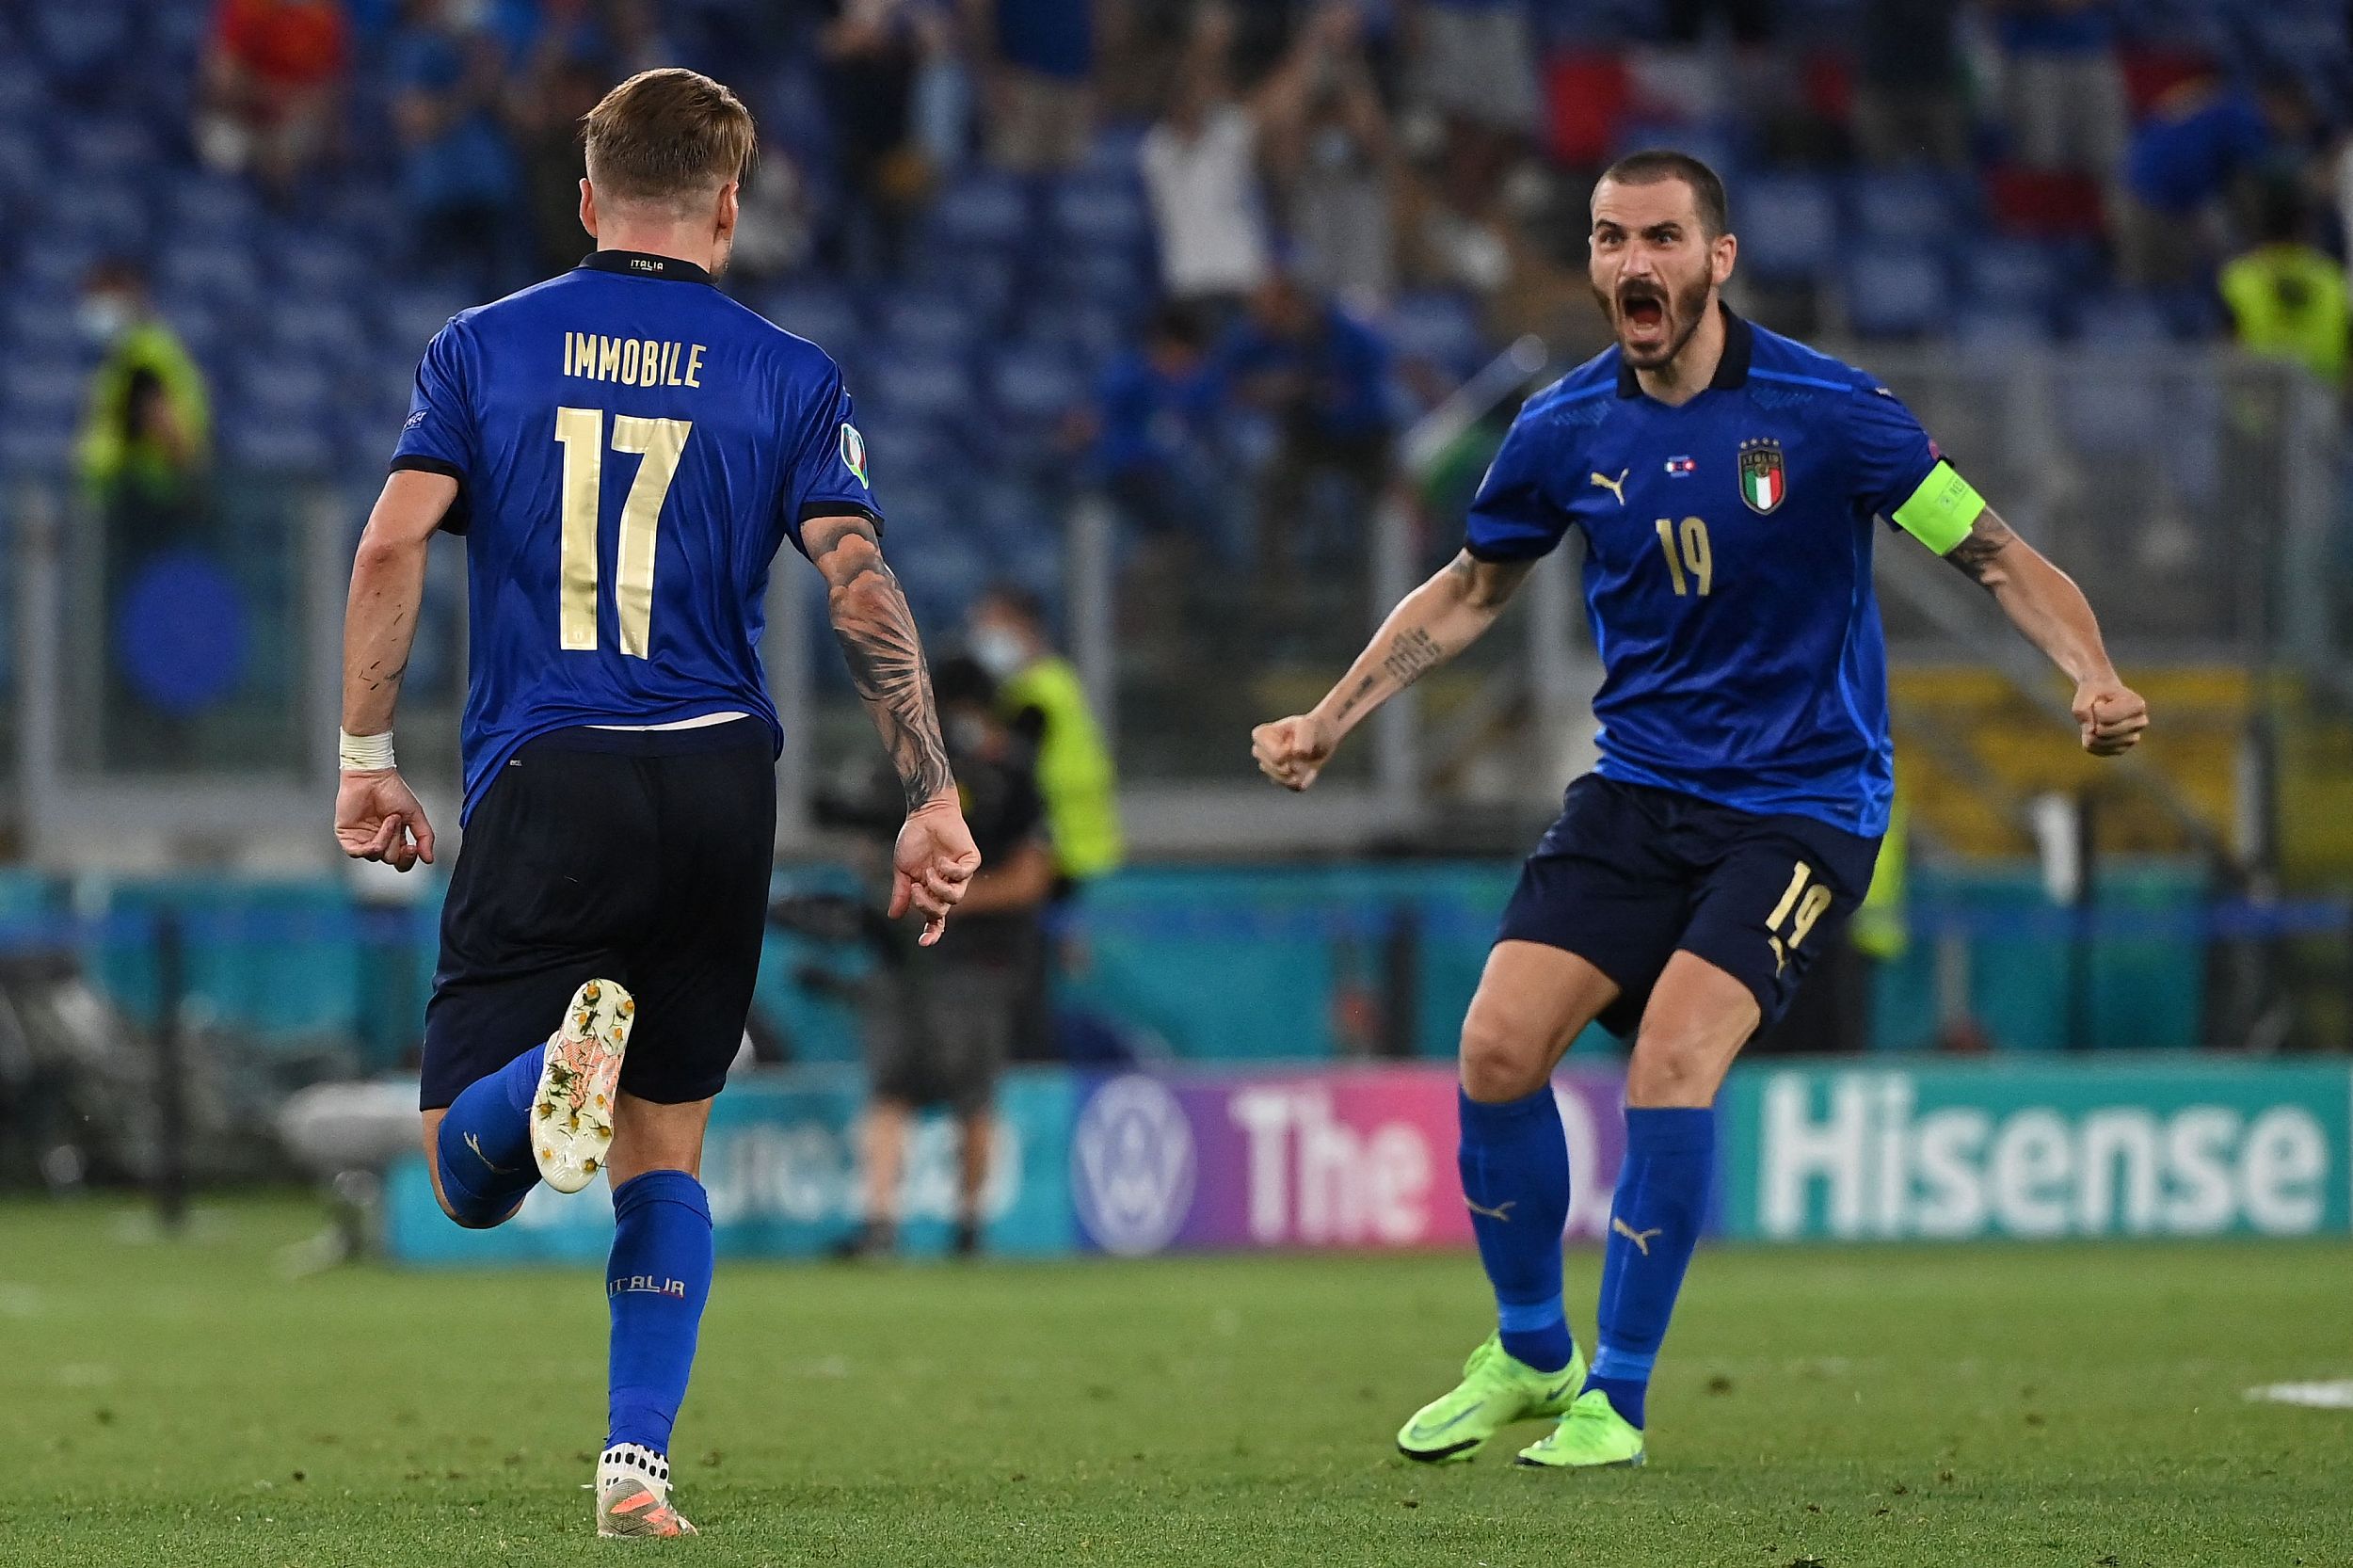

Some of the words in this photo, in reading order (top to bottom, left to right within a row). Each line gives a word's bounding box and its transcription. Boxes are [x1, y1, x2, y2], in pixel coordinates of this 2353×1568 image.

[631, 259, 664, 271] ITALIA
[564, 331, 707, 389] IMMOBILE
[554, 407, 693, 660] 17
[1656, 517, 1712, 596] 19
[1765, 860, 1833, 949] 19
[1229, 1084, 1432, 1244] The
[1760, 1071, 2327, 1239] Hisense
[609, 1275, 684, 1298] ITALIA
